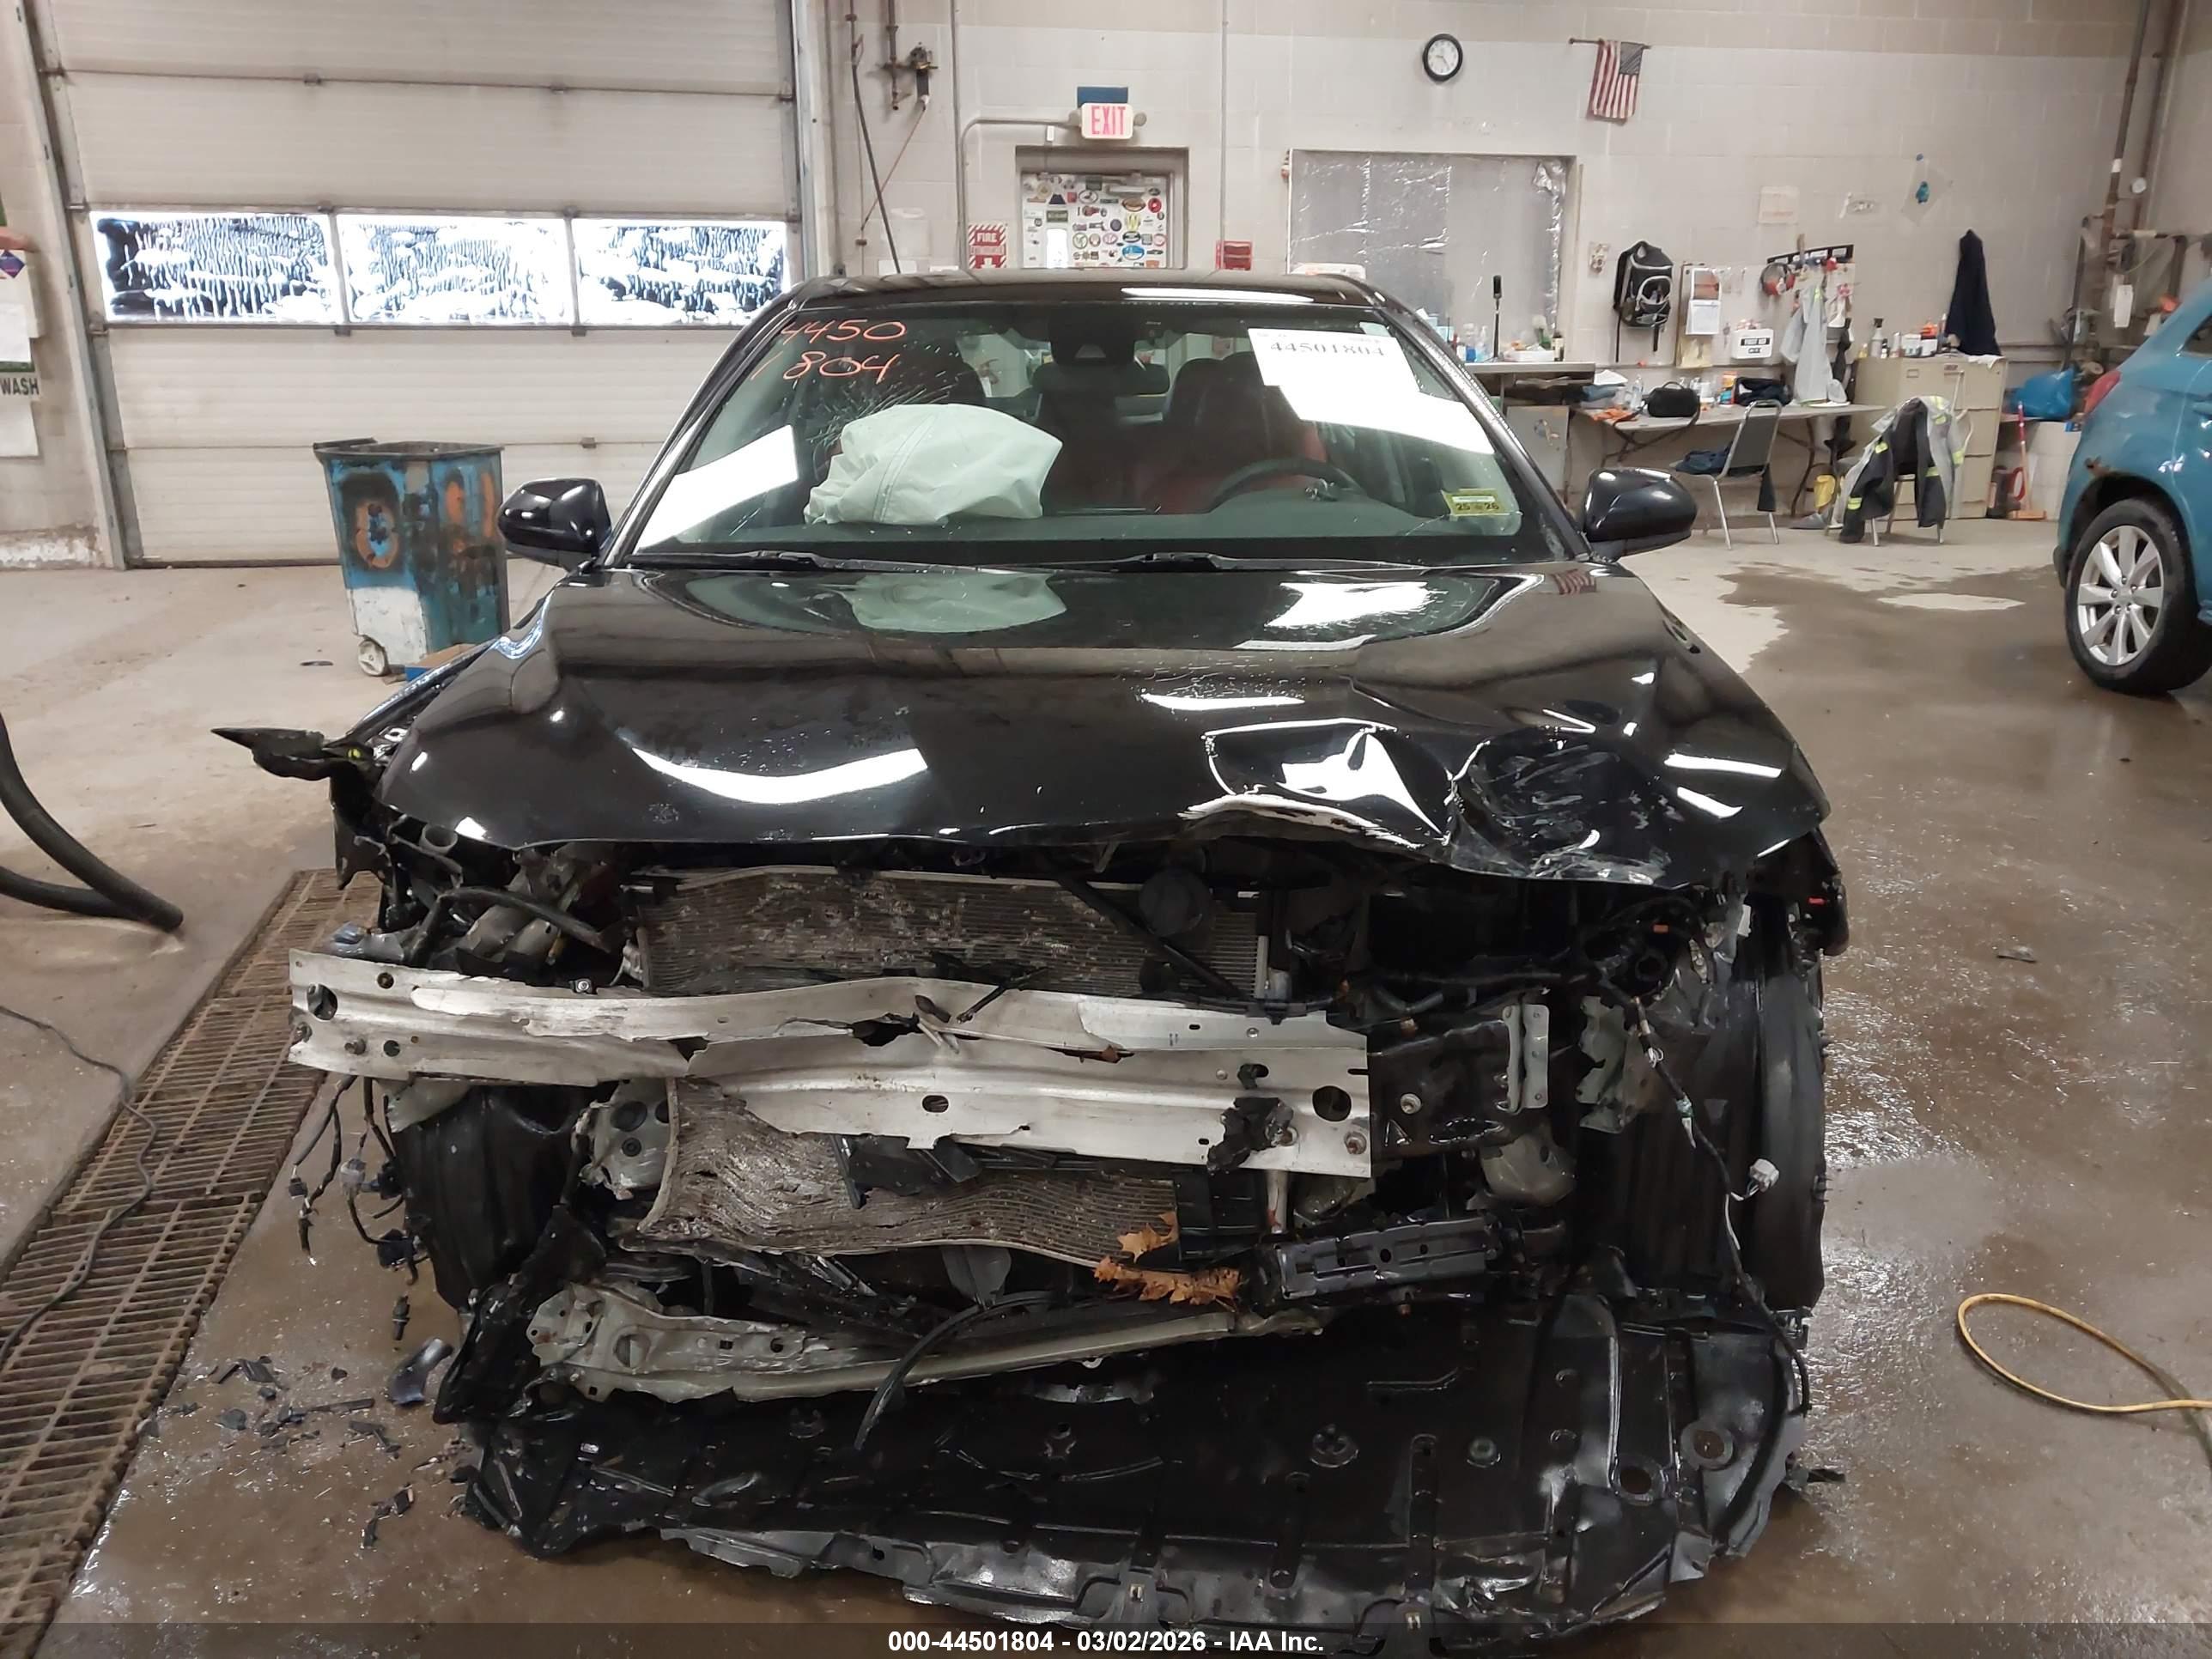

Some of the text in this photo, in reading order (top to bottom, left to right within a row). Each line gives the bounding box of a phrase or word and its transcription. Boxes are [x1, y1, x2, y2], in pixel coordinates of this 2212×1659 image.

[1091, 105, 1127, 135] EXIT
[976, 232, 998, 243] FIRE
[781, 319, 907, 345] 4450
[1270, 342, 1385, 356] 44501804
[0, 377, 40, 396] WASH
